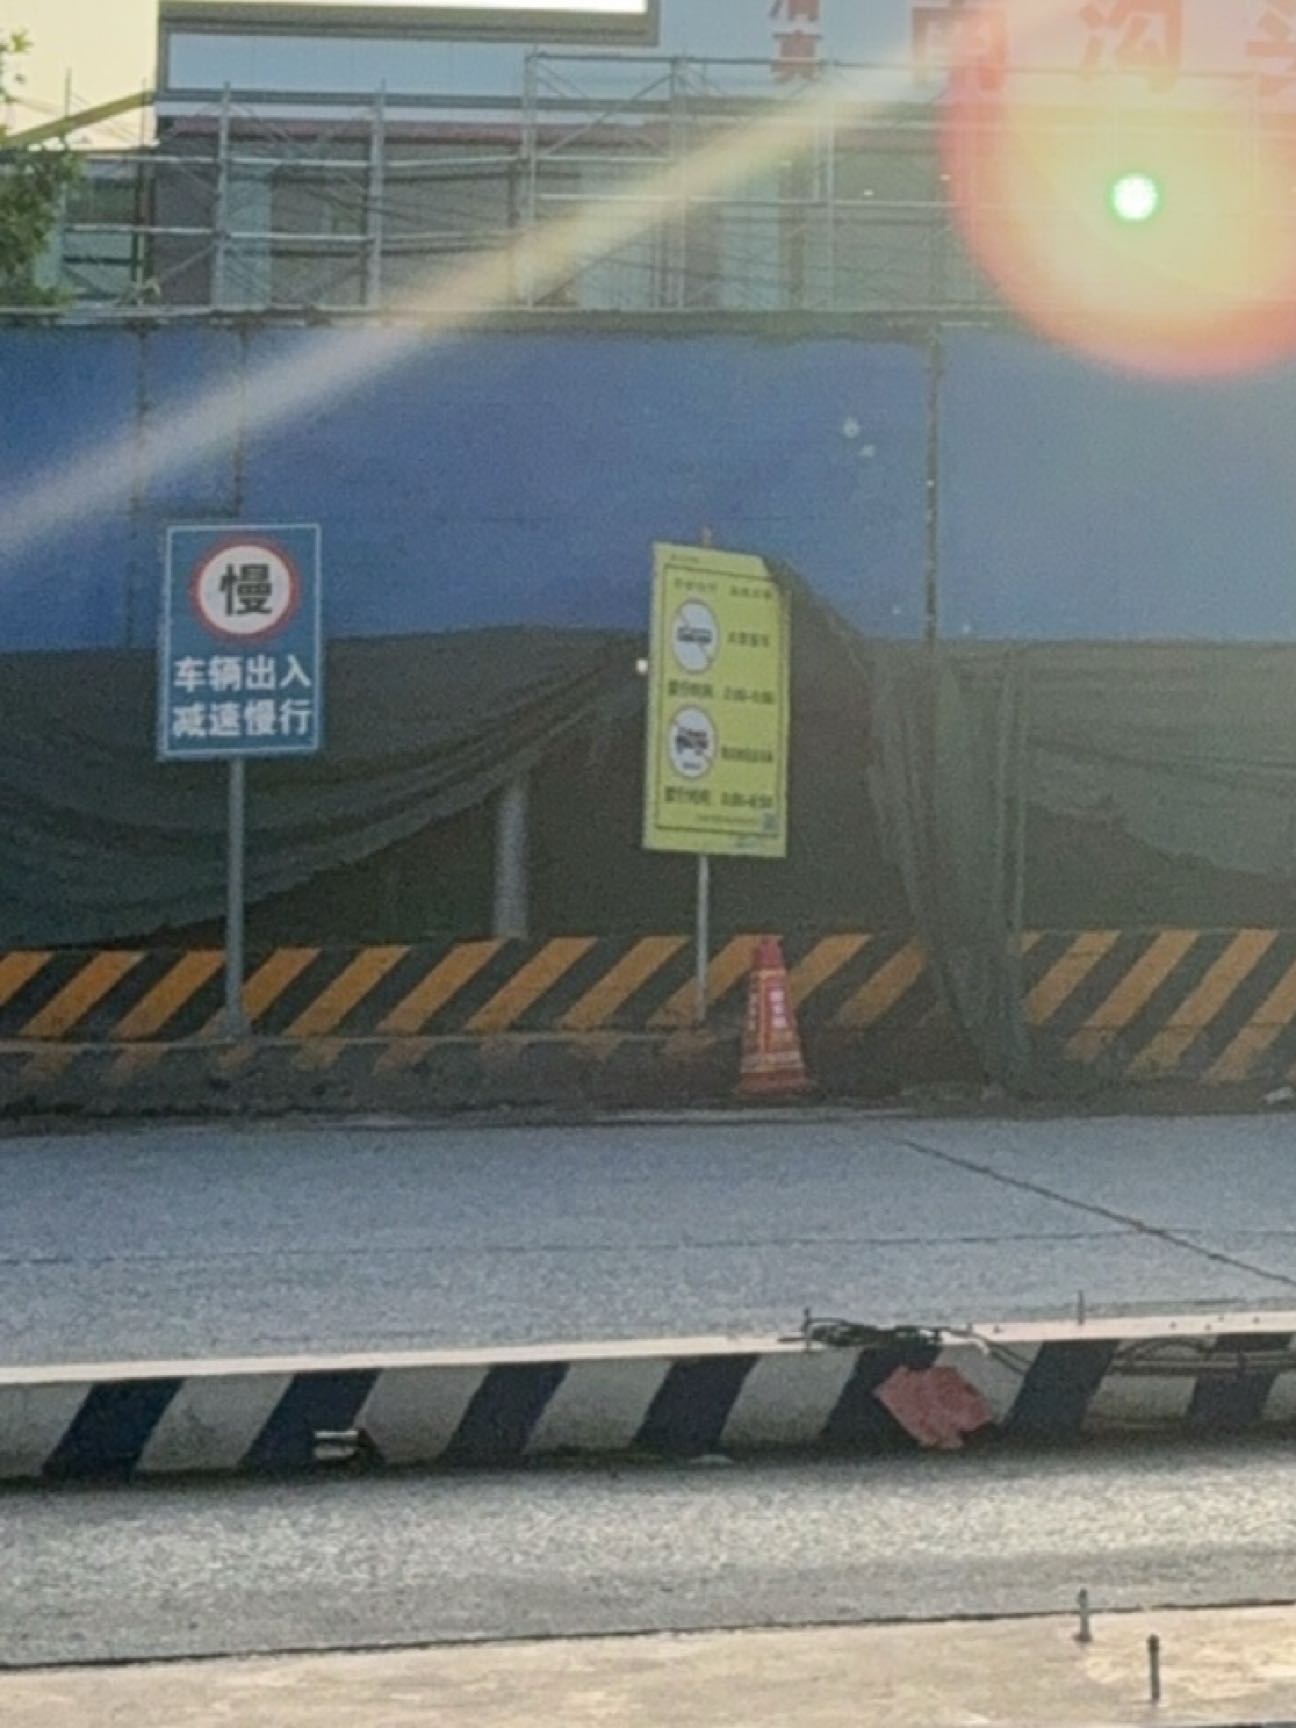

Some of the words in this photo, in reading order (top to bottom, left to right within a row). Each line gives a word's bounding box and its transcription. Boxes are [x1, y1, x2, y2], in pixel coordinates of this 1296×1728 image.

[218, 563, 273, 616] 慢
[173, 654, 312, 693] 车辆出入
[172, 698, 312, 737] 减速慢行
